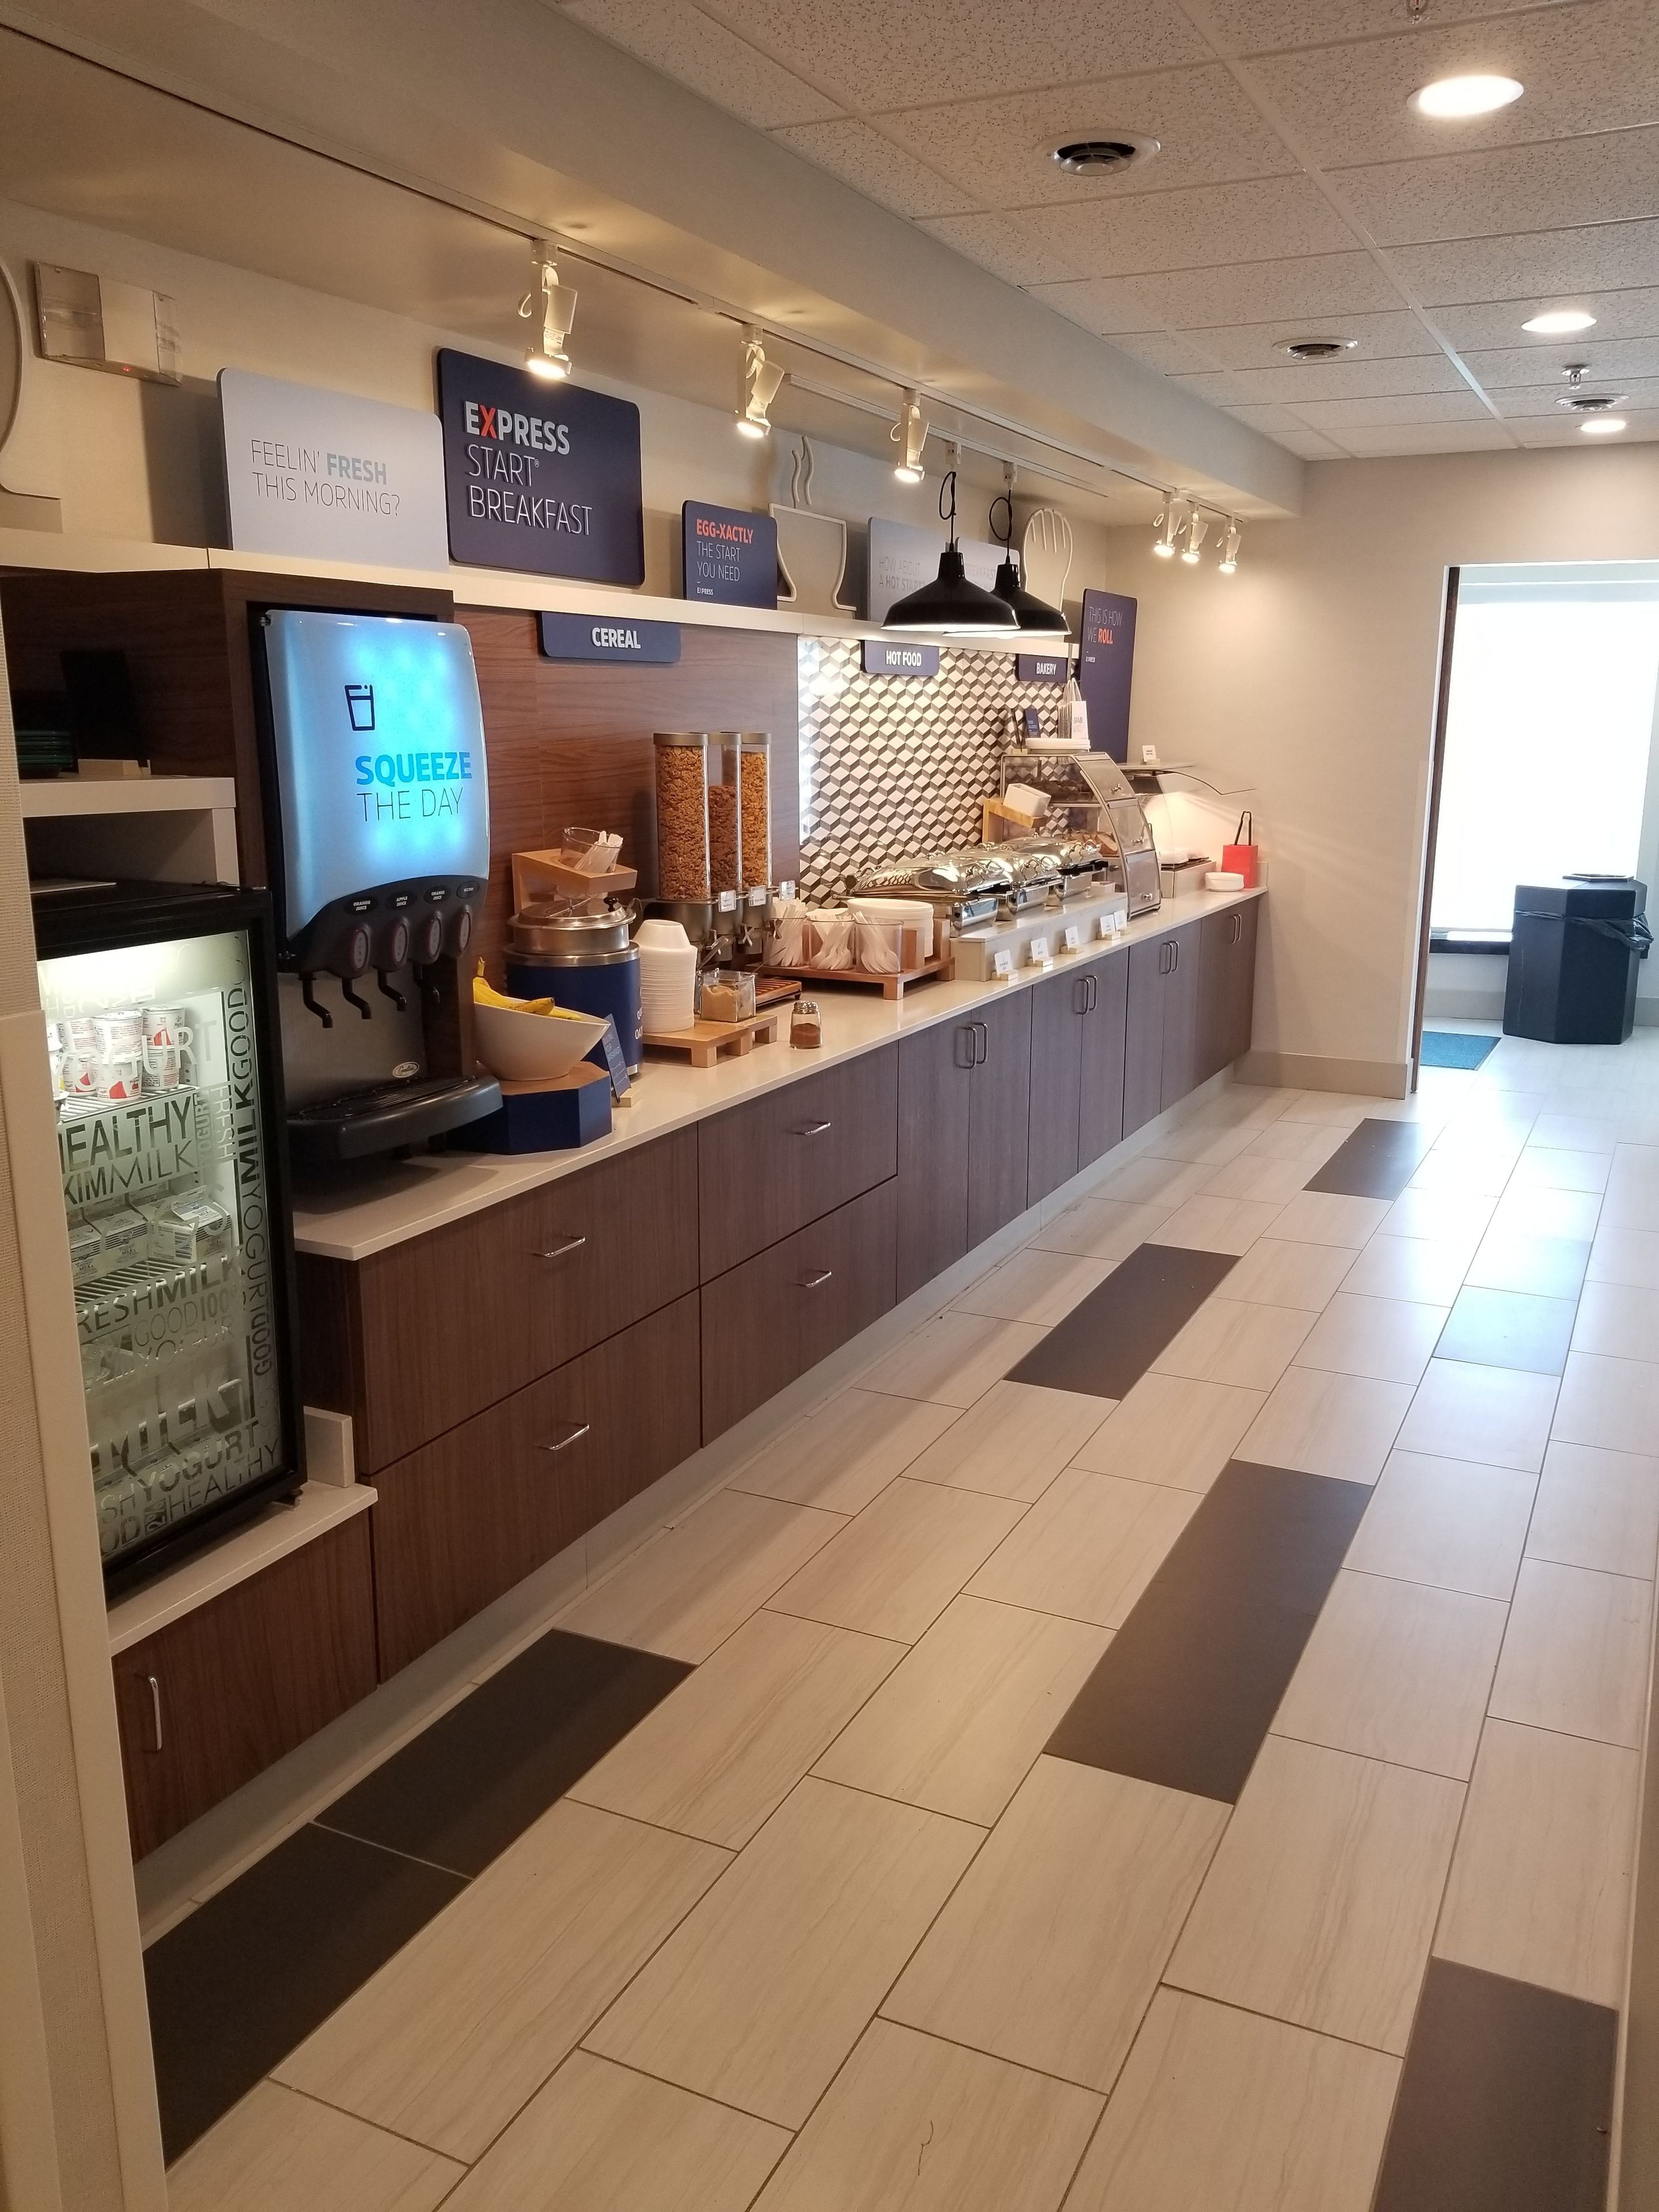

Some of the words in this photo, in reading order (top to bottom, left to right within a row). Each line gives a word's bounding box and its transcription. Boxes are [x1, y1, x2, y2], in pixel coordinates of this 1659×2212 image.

[464, 400, 570, 455] EXPRESS
[251, 439, 320, 473] FEELIN'
[327, 452, 387, 485] FRESH
[252, 472, 297, 502] THIS
[305, 481, 401, 517] MORNING?
[468, 485, 592, 536] BREAKFAST
[696, 518, 753, 544] EGG-XACTLY
[696, 541, 713, 558] THE
[716, 544, 741, 562] START
[697, 561, 715, 579] YOU
[718, 565, 740, 582] NEED
[879, 556, 896, 572] HOW
[899, 559, 921, 577] ABOUT
[880, 574, 885, 589] A
[886, 577, 900, 590] HOT
[1088, 607, 1101, 624] THIS
[1102, 609, 1107, 626] IS
[1109, 610, 1123, 627] HOW
[591, 626, 641, 650] CEREAL
[1087, 627, 1097, 643] WE
[1098, 628, 1113, 645] ROLL
[885, 650, 901, 665] HOT
[902, 652, 922, 666] FOOD
[1036, 662, 1057, 675] BAKERY
[355, 752, 473, 787] SQUEEZE
[357, 791, 411, 823] THE
[421, 786, 465, 818] DAY
